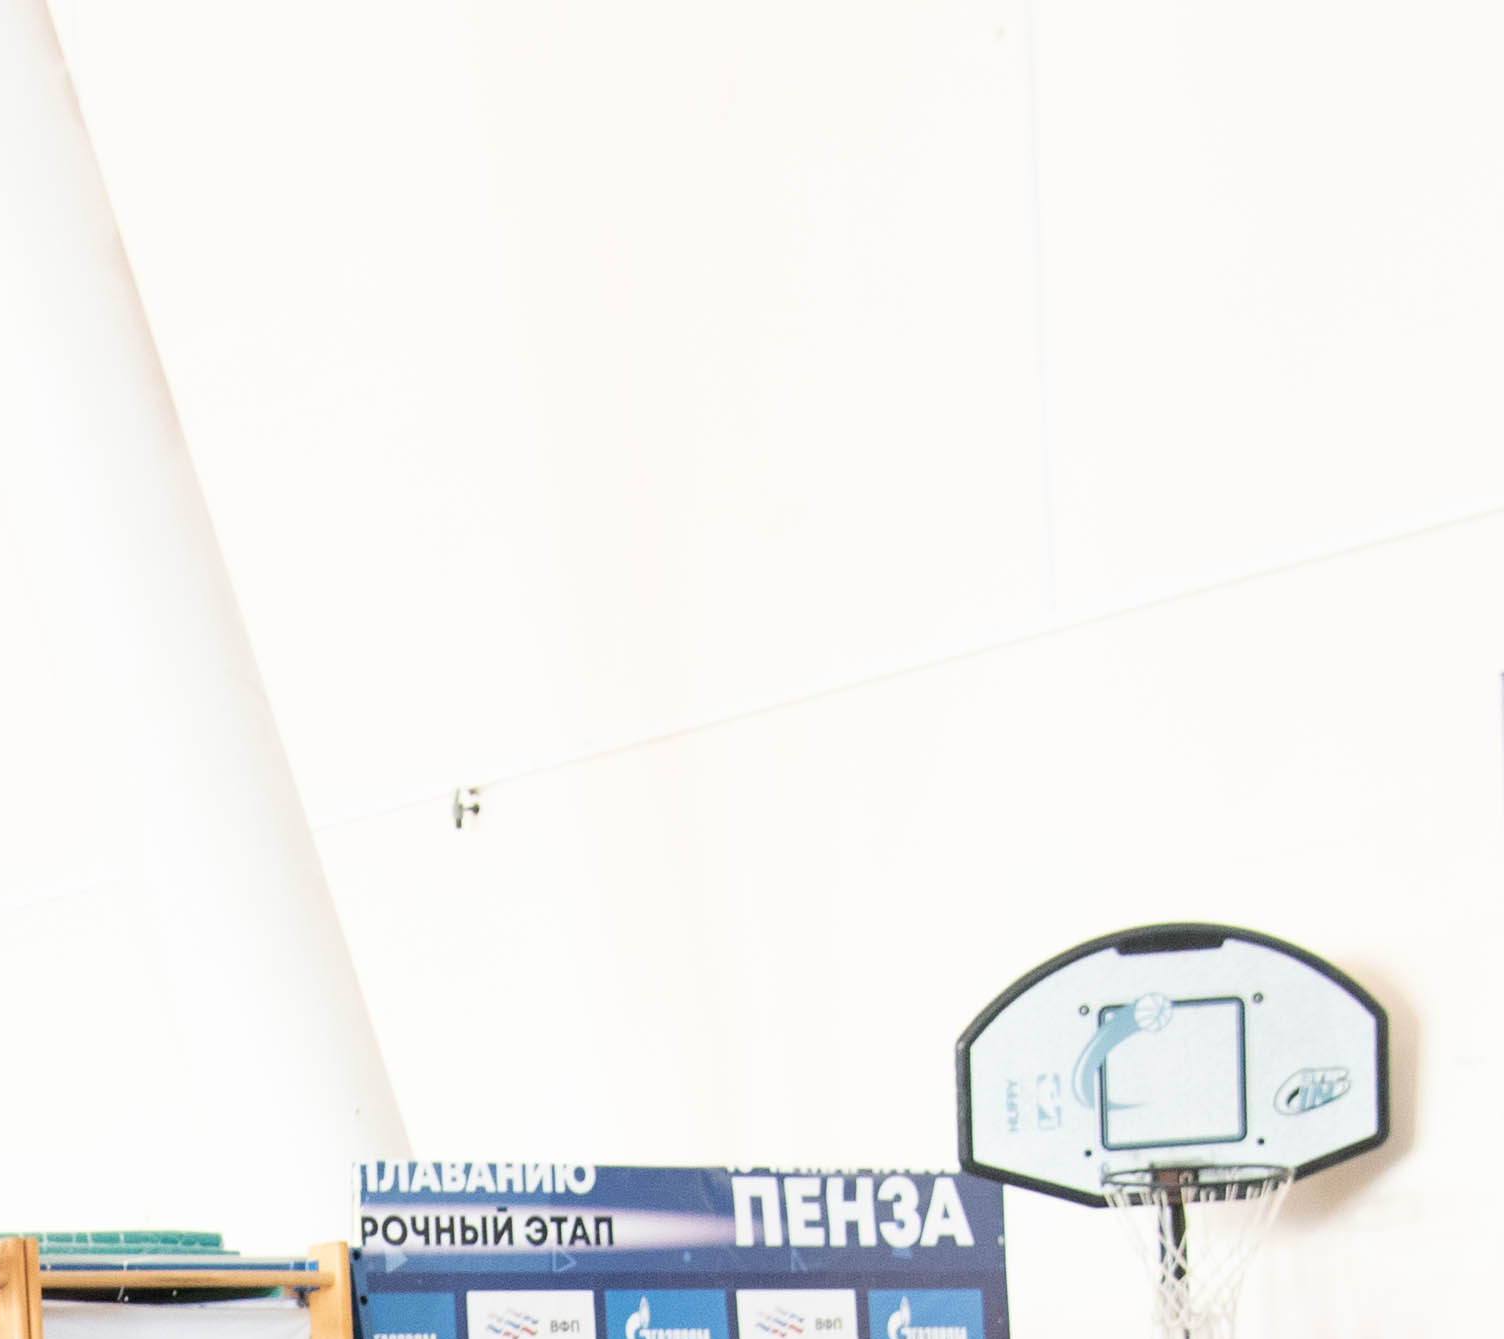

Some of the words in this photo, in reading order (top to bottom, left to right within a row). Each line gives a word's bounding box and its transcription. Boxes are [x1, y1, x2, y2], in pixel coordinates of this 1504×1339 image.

[731, 1175, 976, 1249] ПЕНЗА
[360, 1207, 514, 1247] РОЧНЫЙ
[525, 1215, 614, 1247] ЭТАП
[550, 1319, 580, 1333] ВФП
[815, 1317, 843, 1331] ВФП
